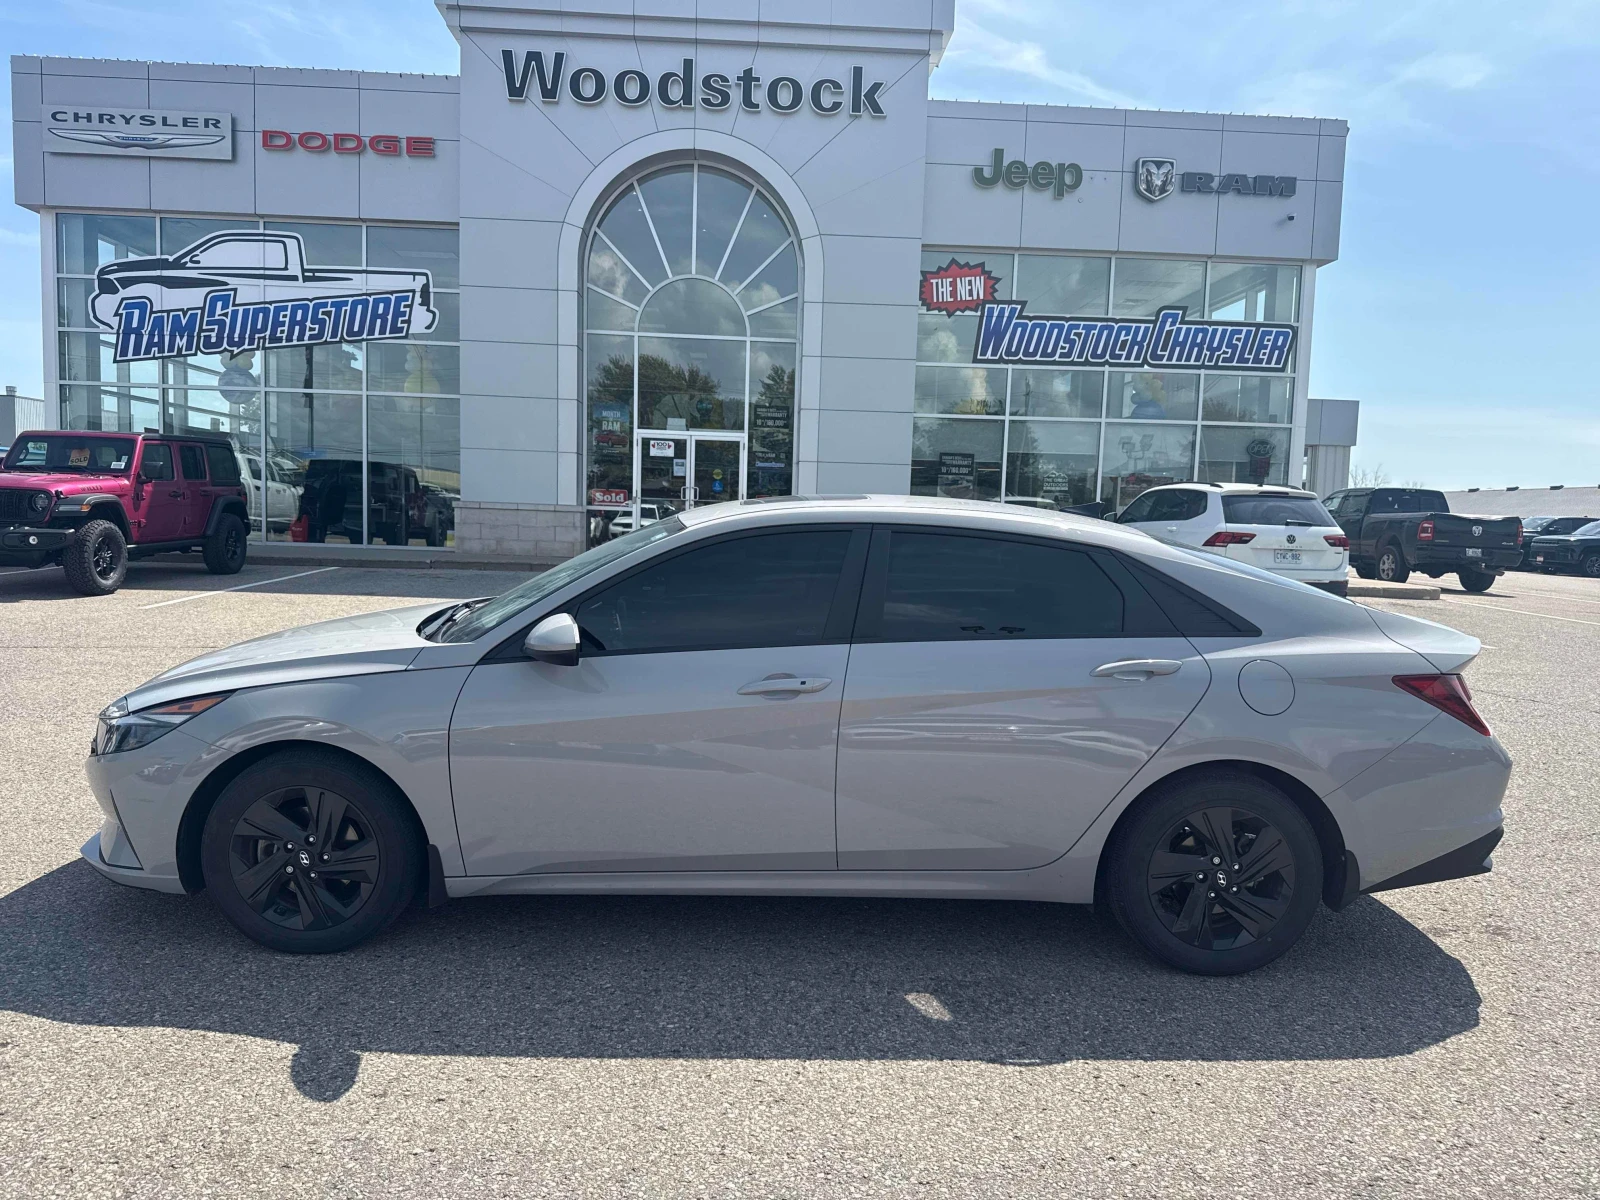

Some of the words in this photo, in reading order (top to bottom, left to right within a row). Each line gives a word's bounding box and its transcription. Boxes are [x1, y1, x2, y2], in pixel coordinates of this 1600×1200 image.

[501, 49, 887, 118] Woodstock
[50, 110, 222, 130] CHRYSLER
[261, 129, 436, 157] DODGE
[972, 148, 1083, 199] Jeep
[1181, 171, 1297, 197] RAM
[930, 278, 953, 303] THE
[957, 276, 985, 302] NEW
[116, 296, 203, 361] RAM
[200, 289, 416, 357] SUPERSTORE
[977, 304, 1150, 363] WOODSTOCK
[1146, 310, 1293, 368] CHRYSLER
[602, 421, 620, 430] RAM
[70, 456, 88, 464] SOLD
[1250, 444, 1274, 454] OPEN
[595, 492, 625, 503] Sold
